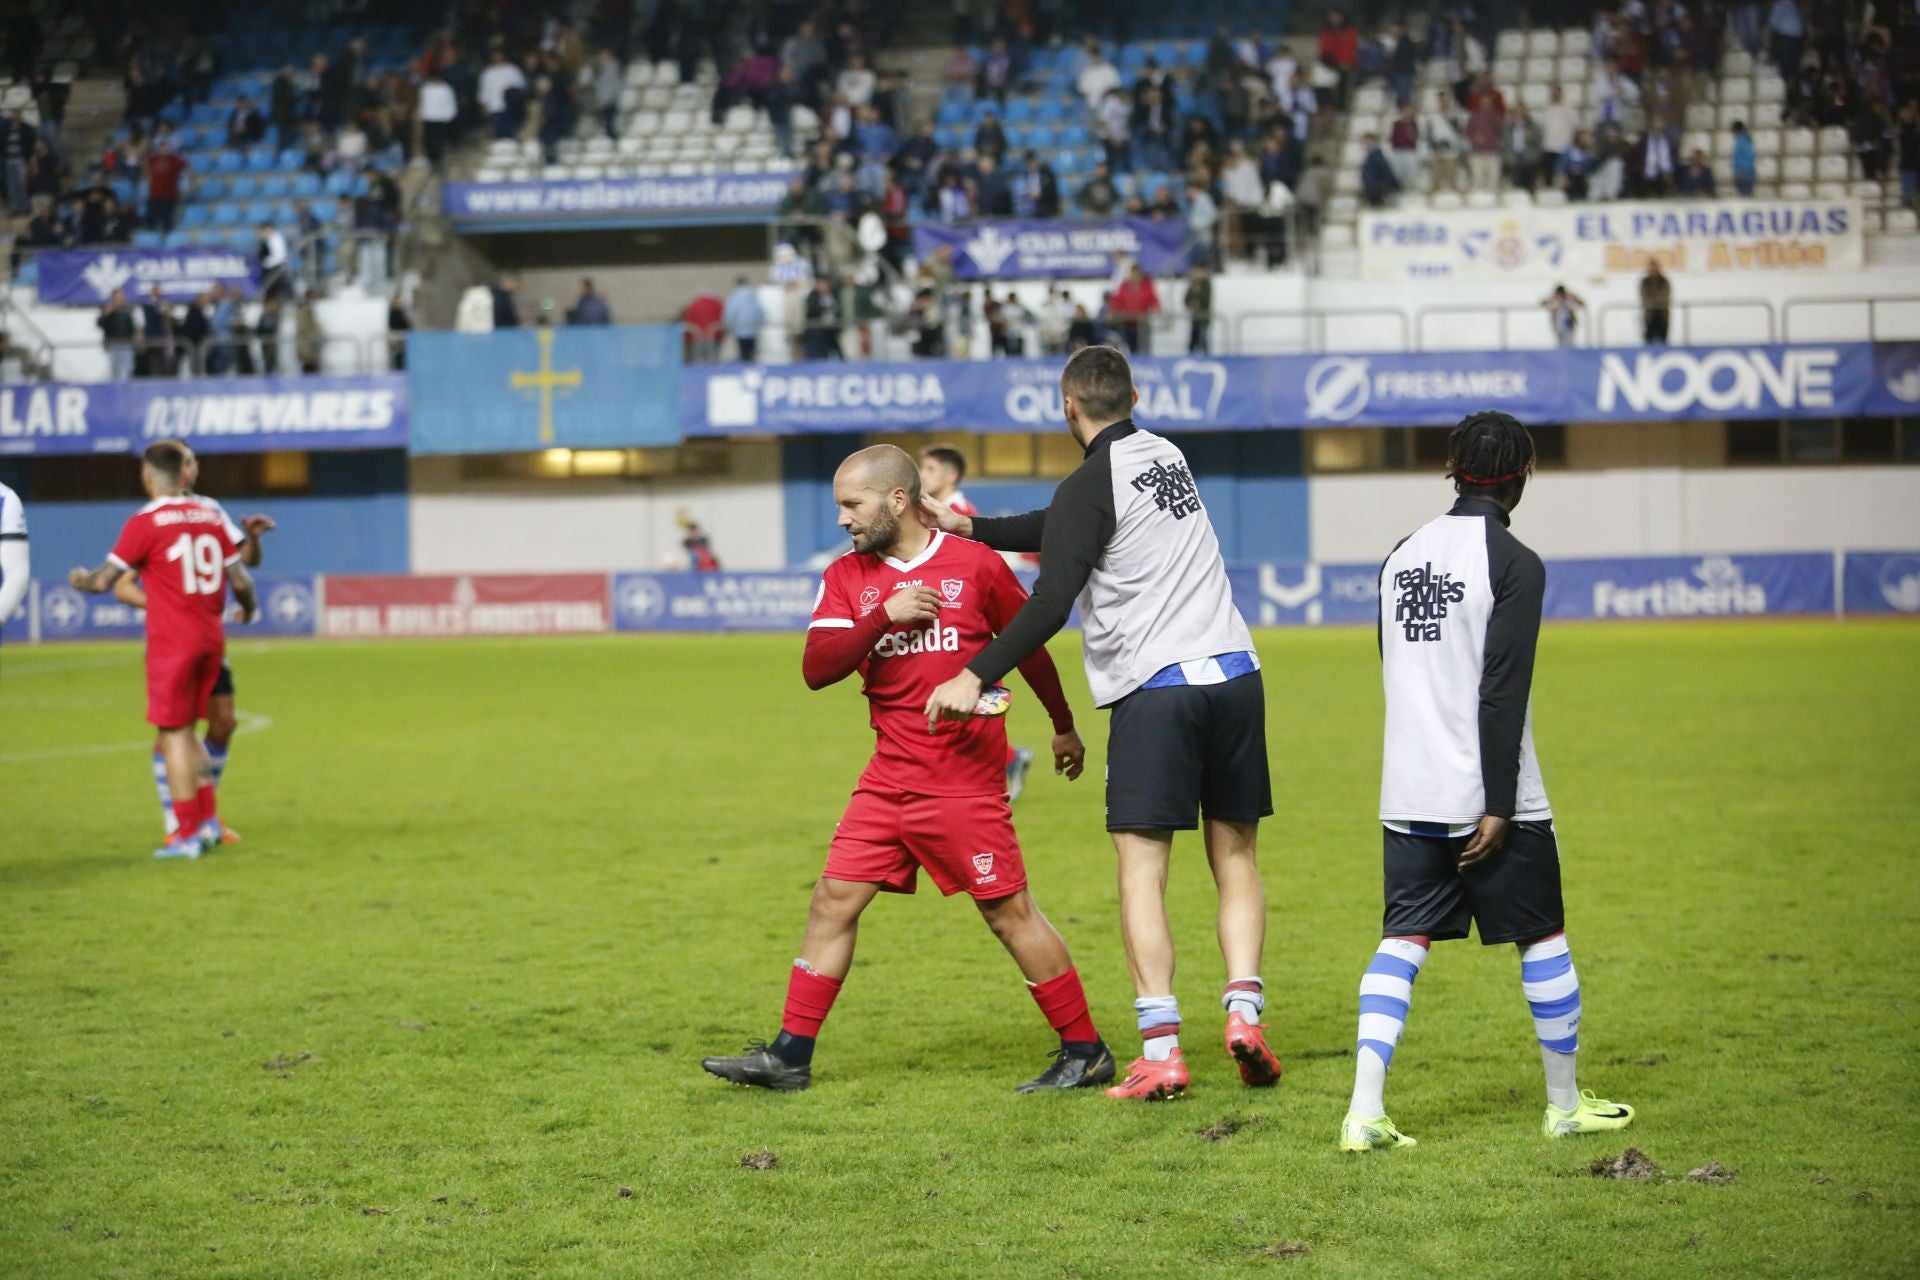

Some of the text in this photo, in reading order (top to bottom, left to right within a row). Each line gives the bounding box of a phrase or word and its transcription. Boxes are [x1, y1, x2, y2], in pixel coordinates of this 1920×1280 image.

[1576, 208, 1849, 240] EL PARAGUAS
[763, 372, 945, 407] PRECUSA
[1373, 368, 1529, 400] FRESAMEX
[1597, 348, 1838, 413] NOONE
[165, 532, 224, 596] 19
[1393, 561, 1432, 591] real
[1401, 572, 1466, 603] avilés
[1592, 576, 1767, 618] Fertiberia
